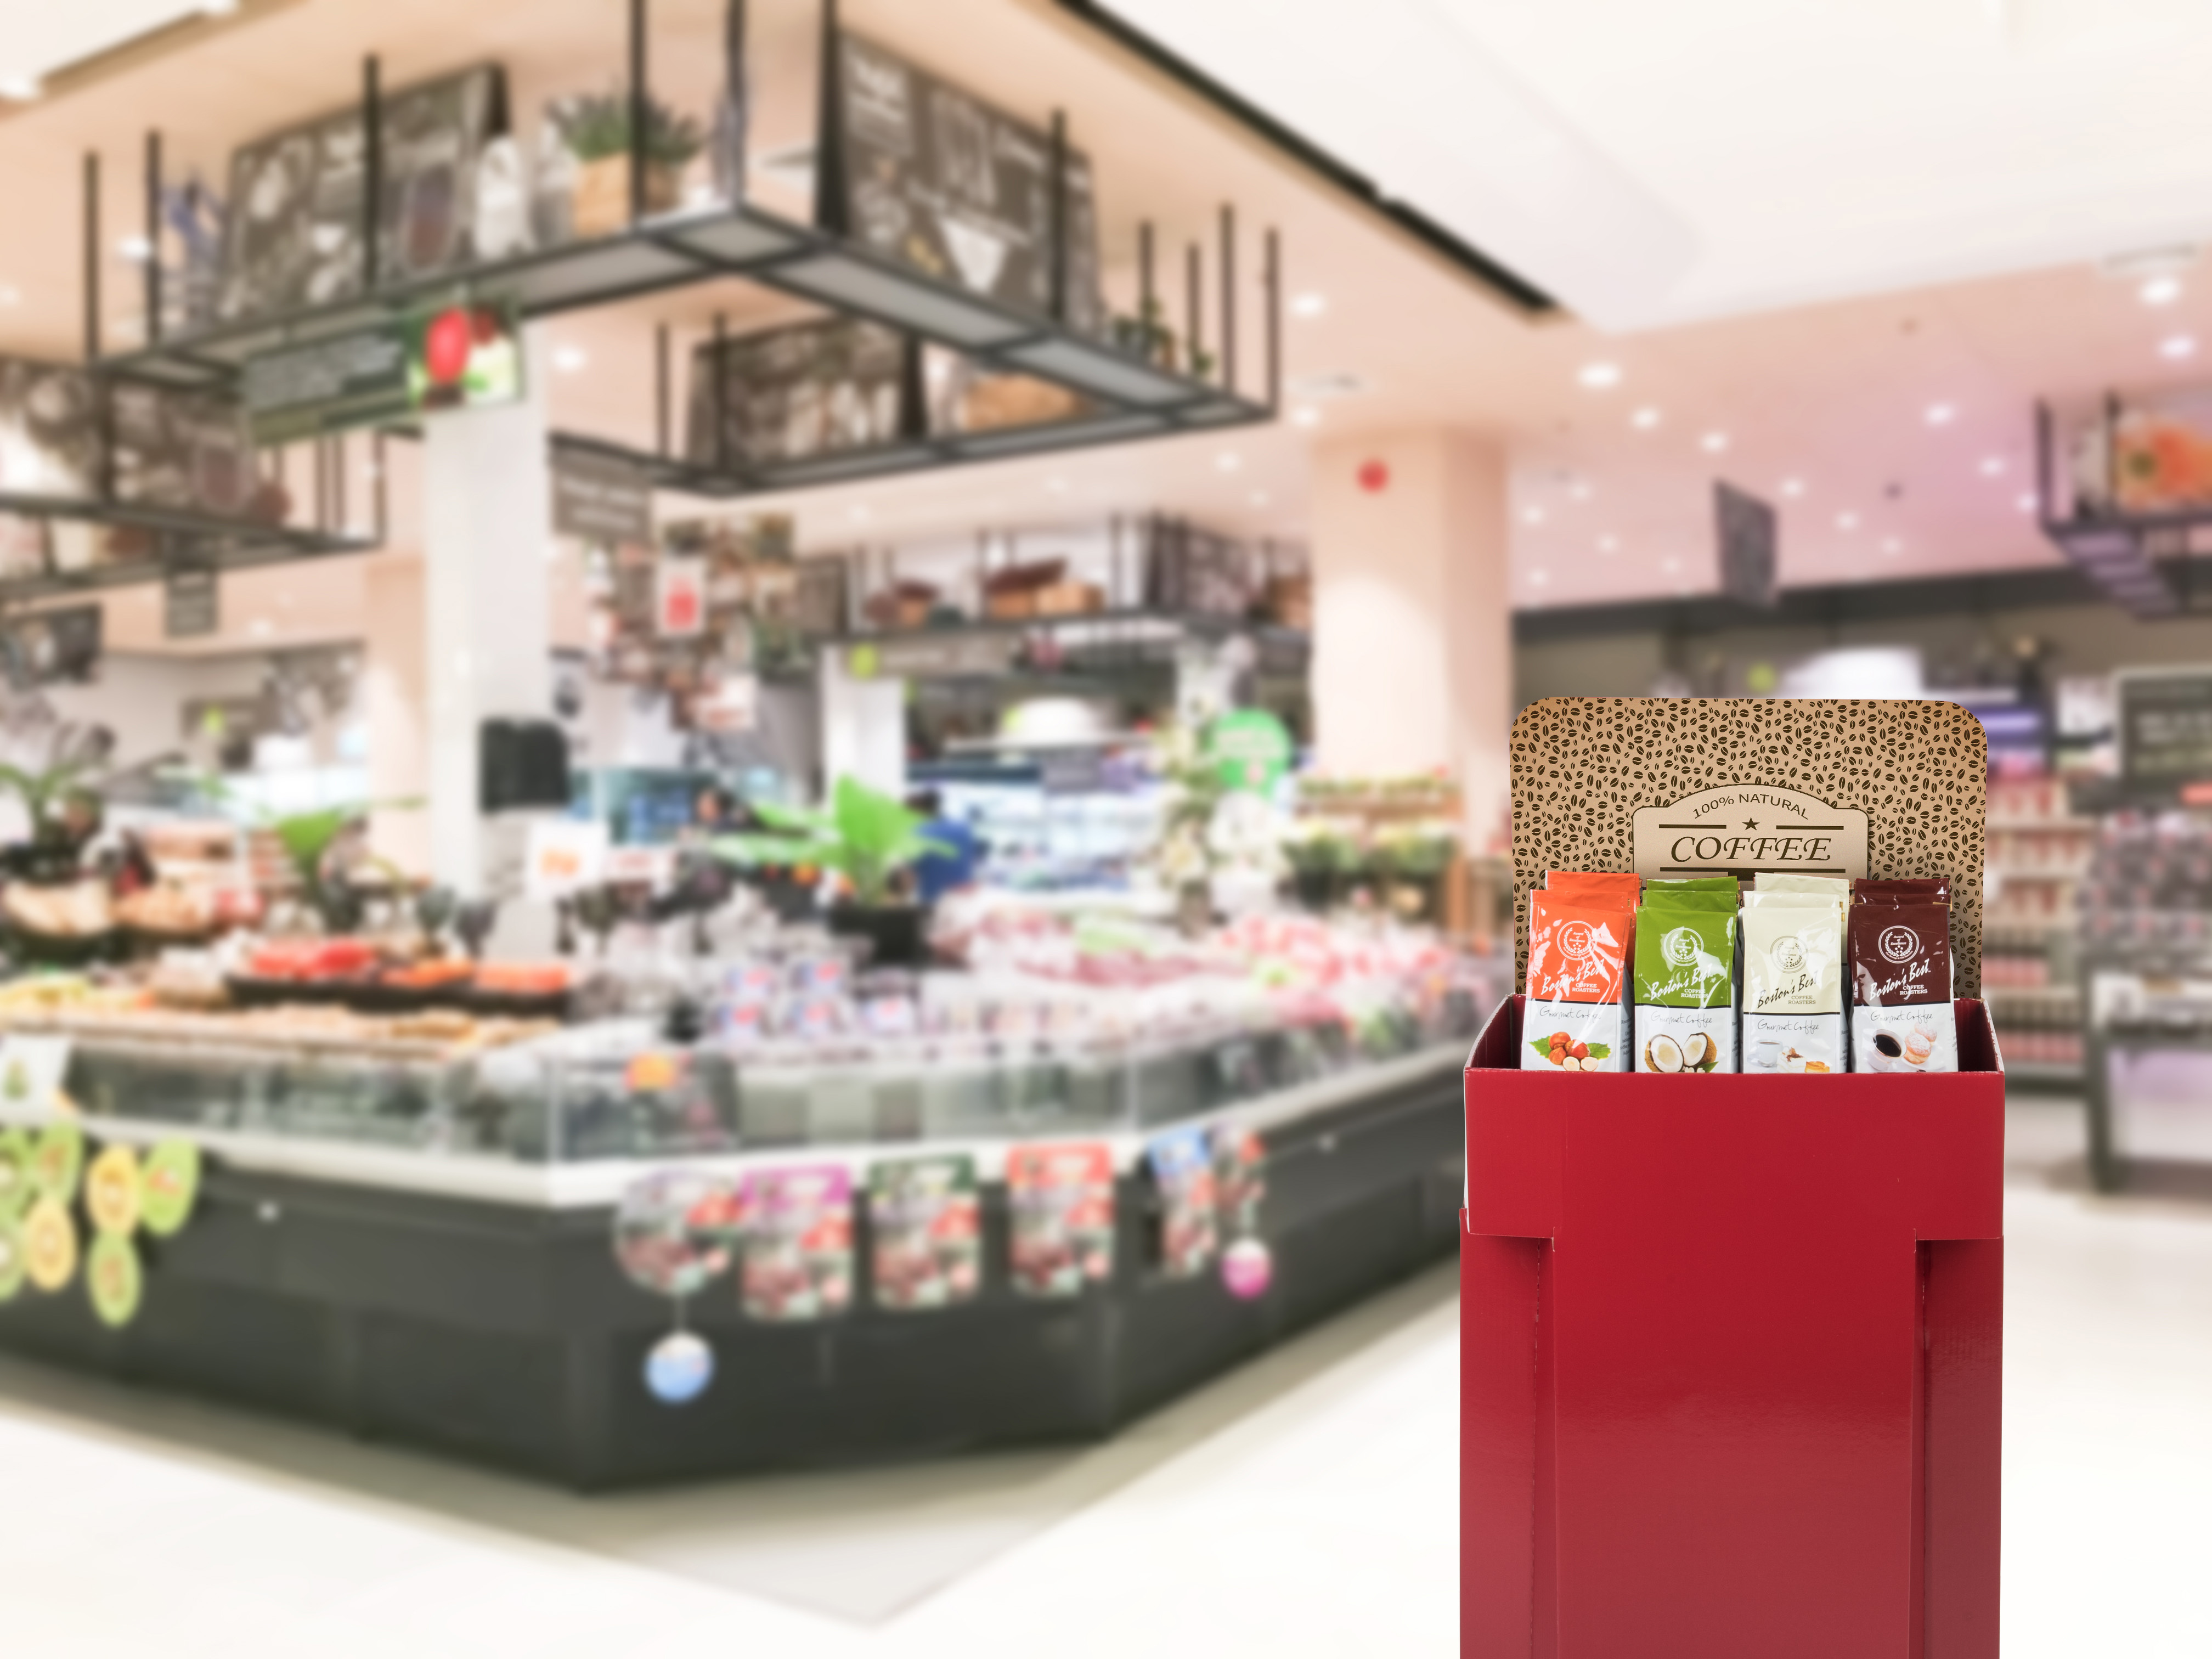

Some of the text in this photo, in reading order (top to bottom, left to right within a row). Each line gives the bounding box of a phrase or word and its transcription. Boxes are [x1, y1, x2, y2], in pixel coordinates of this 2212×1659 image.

[1692, 793, 1808, 820] 100% NATURAL
[1671, 836, 1832, 862] COFFEE
[1583, 958, 1605, 980] Best
[1870, 958, 1931, 1001] Boston's Best
[1650, 963, 1713, 1001] Boston's Best
[1757, 970, 1818, 1008] Boston's Best
[1539, 1006, 1575, 1019] Gourmet
[1651, 1011, 1712, 1028] Gourmet Coffee
[1870, 1009, 1933, 1024] Gourmet Coffee
[1757, 1019, 1819, 1035] Gourmet Coffee
